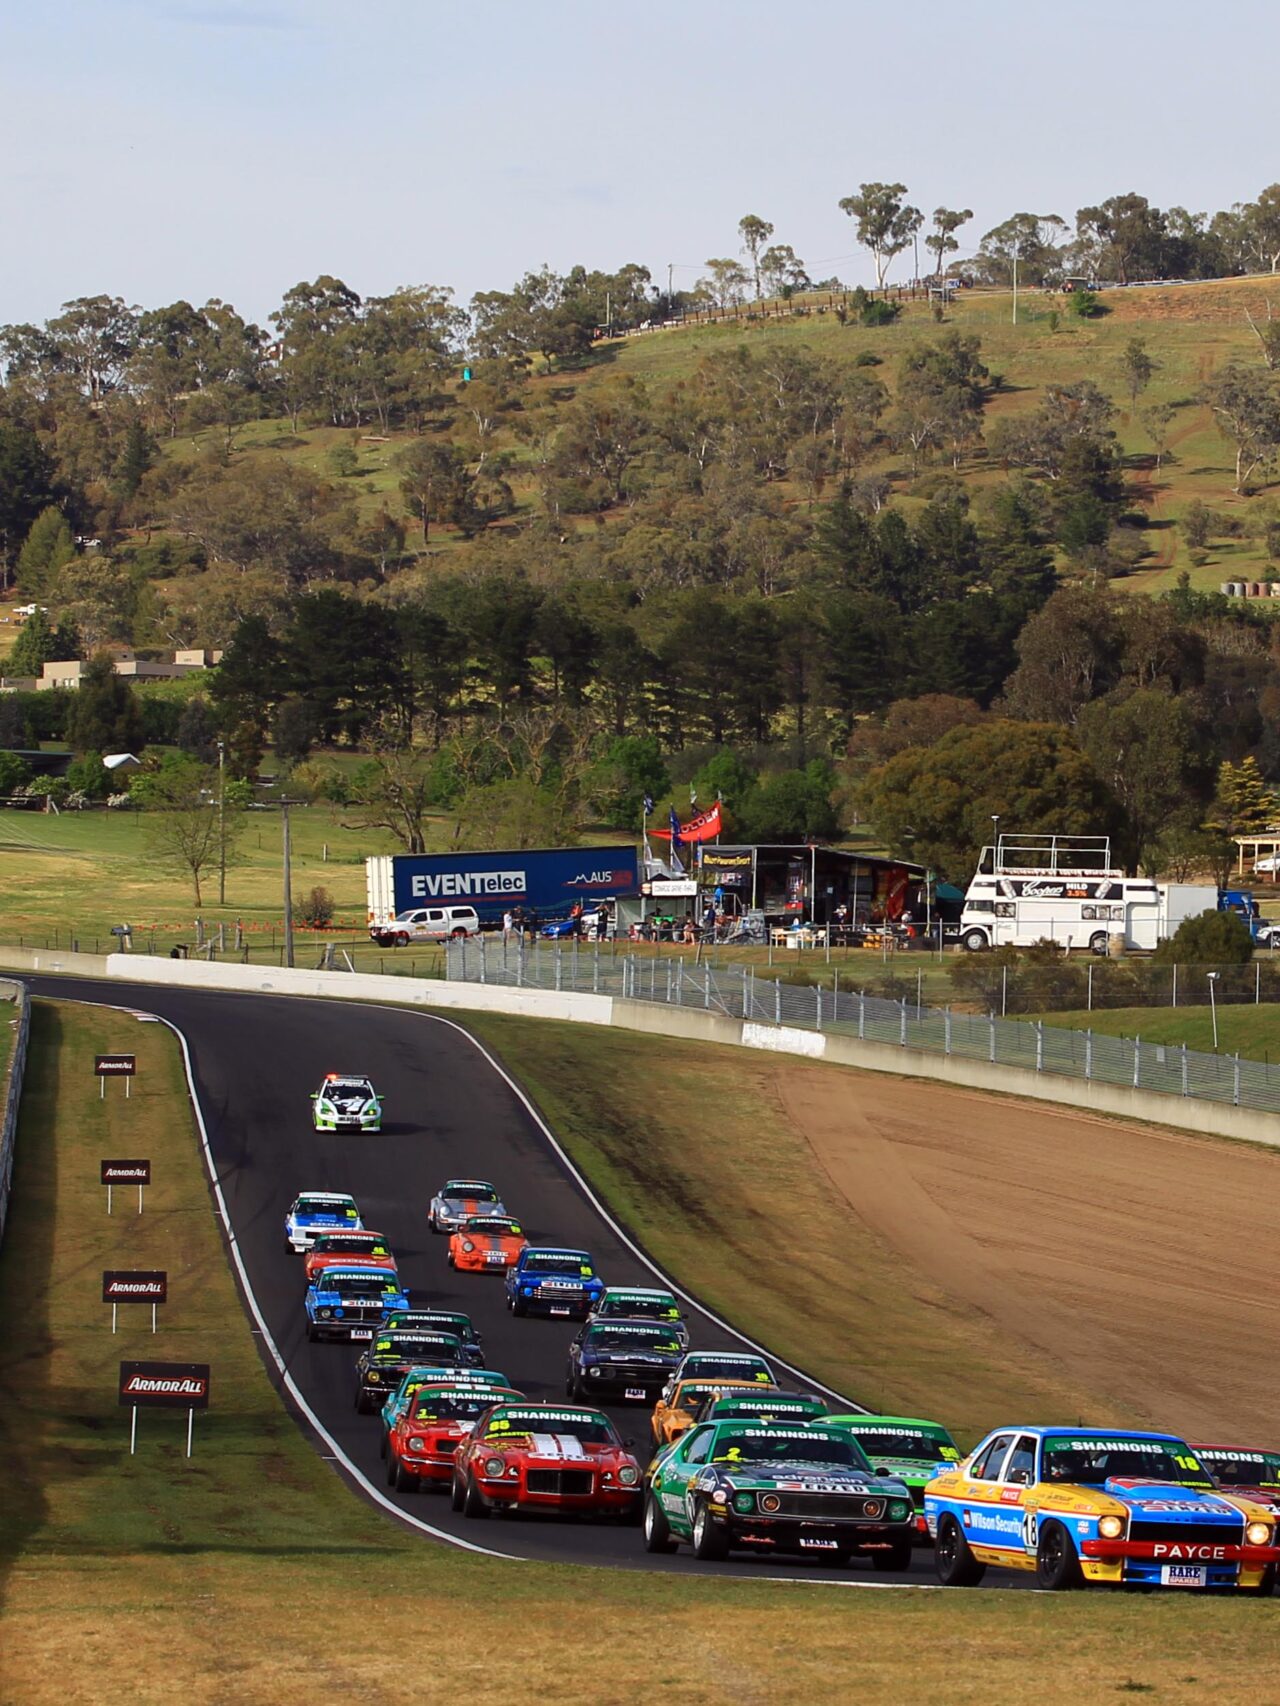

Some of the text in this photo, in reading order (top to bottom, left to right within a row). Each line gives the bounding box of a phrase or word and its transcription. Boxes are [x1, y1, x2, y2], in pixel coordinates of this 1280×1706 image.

[680, 807, 719, 833] OLDEN
[412, 872, 524, 897] EVENTelec
[535, 1253, 582, 1262] SHANNONS
[406, 1314, 453, 1322] SHANNONS
[604, 1325, 660, 1335] SHANNONS
[393, 1335, 445, 1344] SHANNONS
[701, 1357, 752, 1365] SHANNONS
[427, 1374, 485, 1383] SHANNONS
[440, 1392, 505, 1402] SHANNONS
[739, 1402, 803, 1412] SHANNONS
[506, 1411, 592, 1423] SHANNONS
[744, 1429, 829, 1441] SHANNONS
[851, 1427, 923, 1438] SHANNONS
[1071, 1441, 1164, 1454] SHANNONS
[1174, 1456, 1200, 1471] 18
[805, 1483, 866, 1493] ENZED
[971, 1511, 1022, 1538] Wilson Security
[1023, 1512, 1037, 1546] 18
[1153, 1544, 1226, 1560] PAYCE
[1168, 1566, 1201, 1577] RARE
[1168, 1576, 1201, 1585] SPARES
